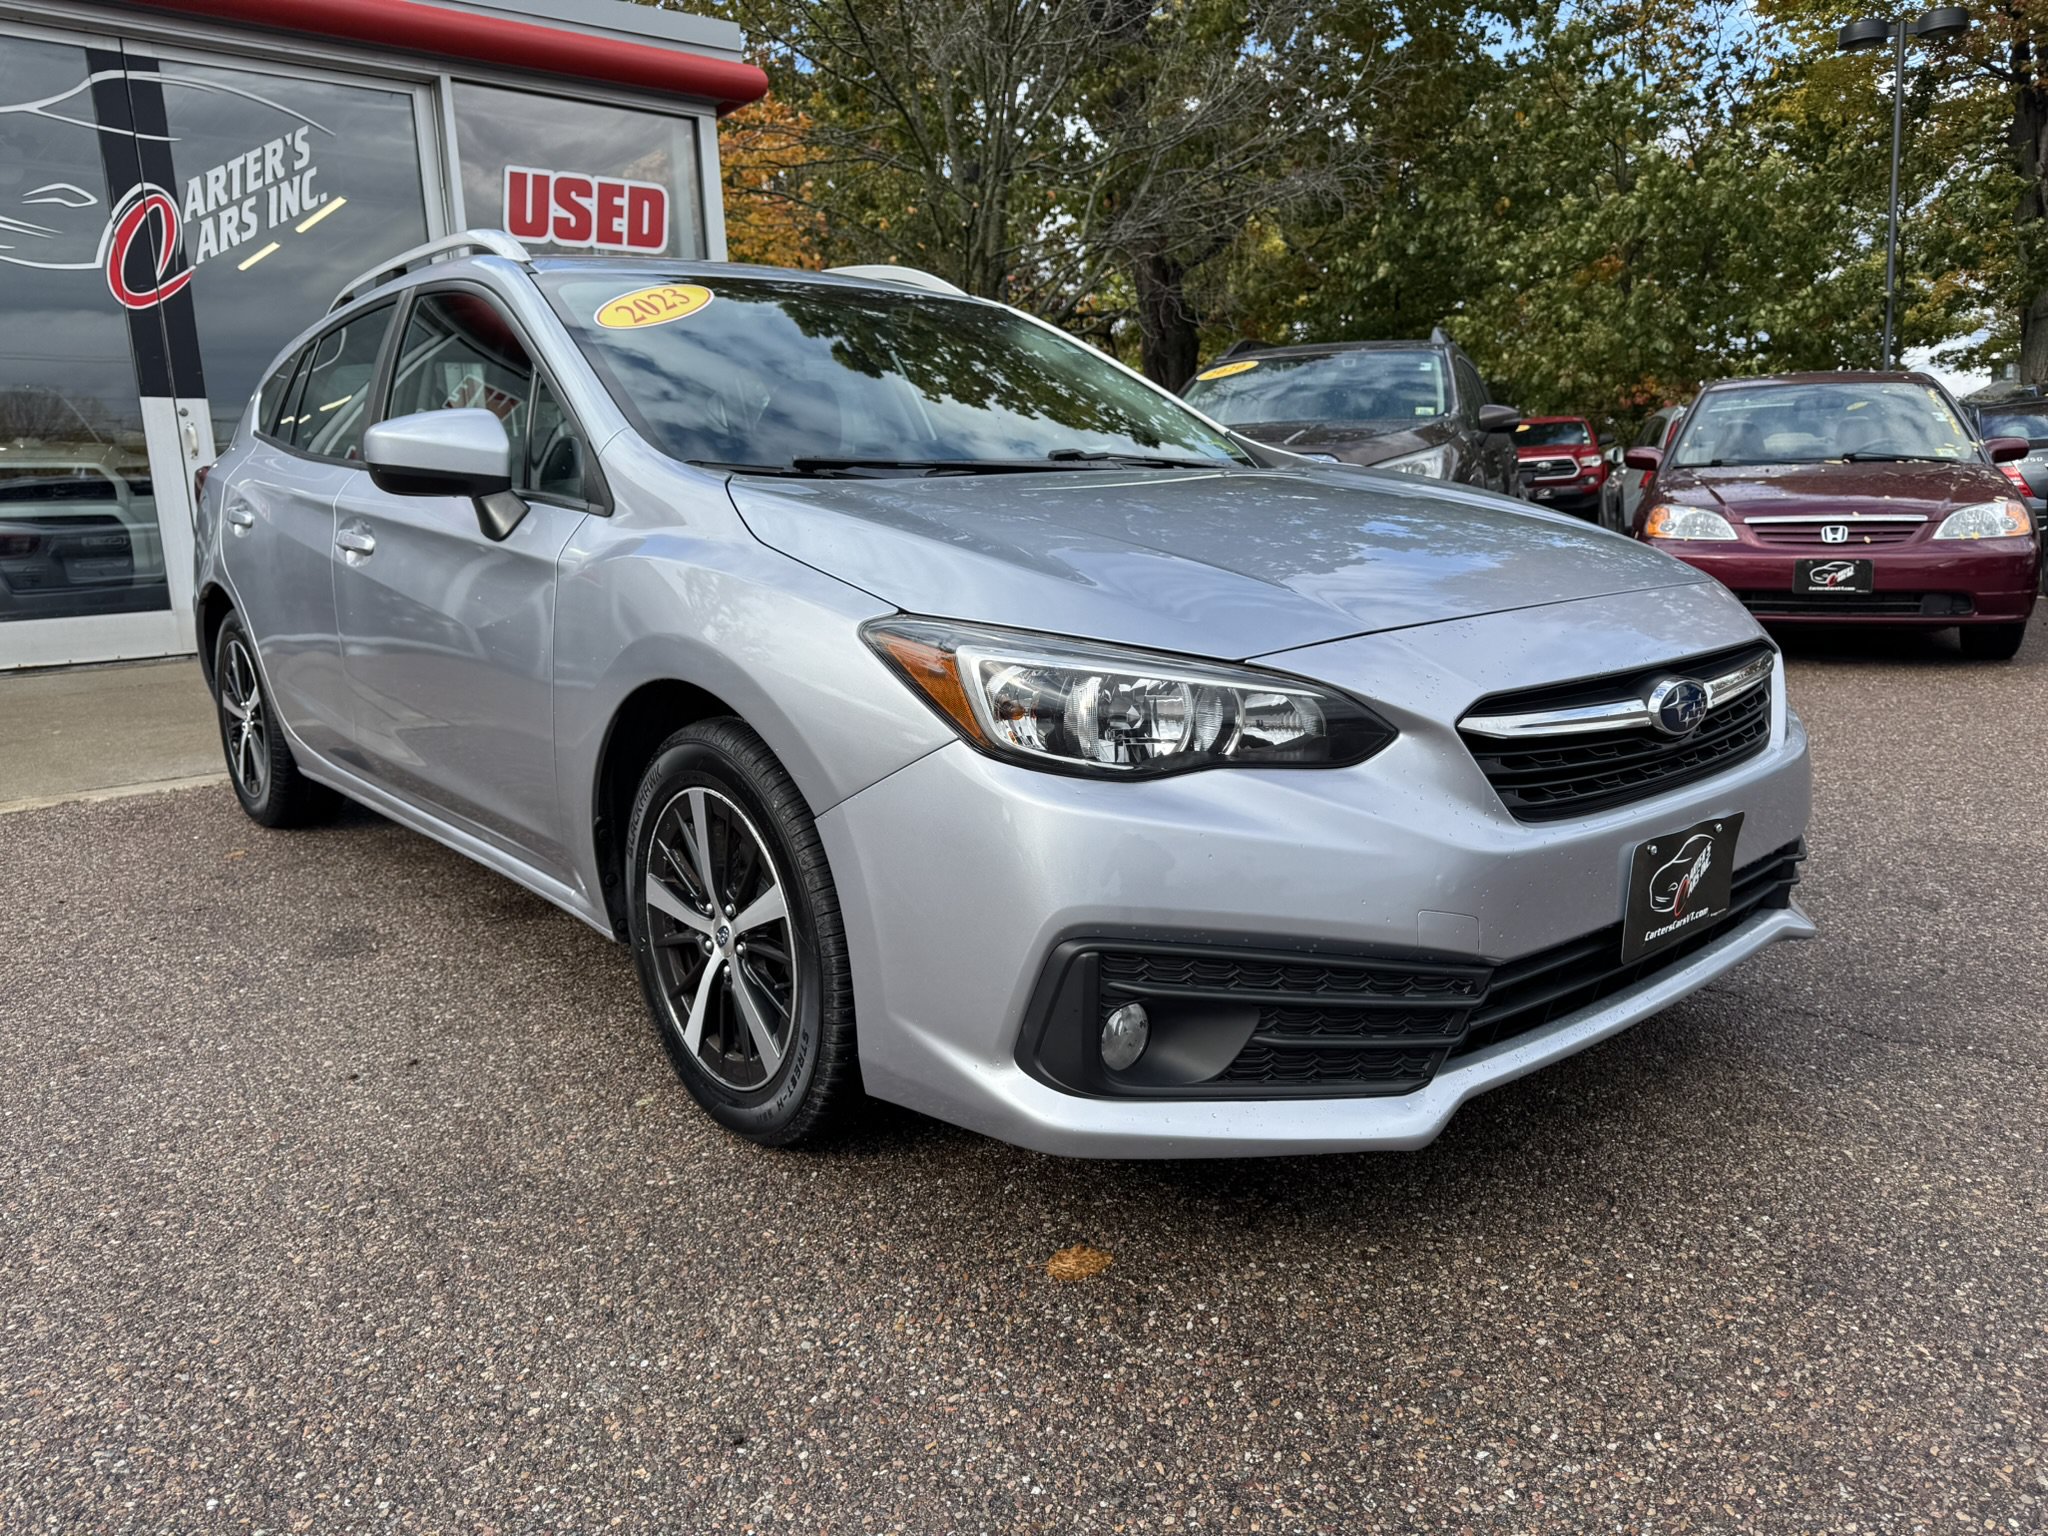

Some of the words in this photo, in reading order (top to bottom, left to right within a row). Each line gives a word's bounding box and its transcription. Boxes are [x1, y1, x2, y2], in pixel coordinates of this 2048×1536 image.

[267, 167, 328, 230] INC.
[506, 169, 666, 250] USED
[615, 288, 691, 324] 2023
